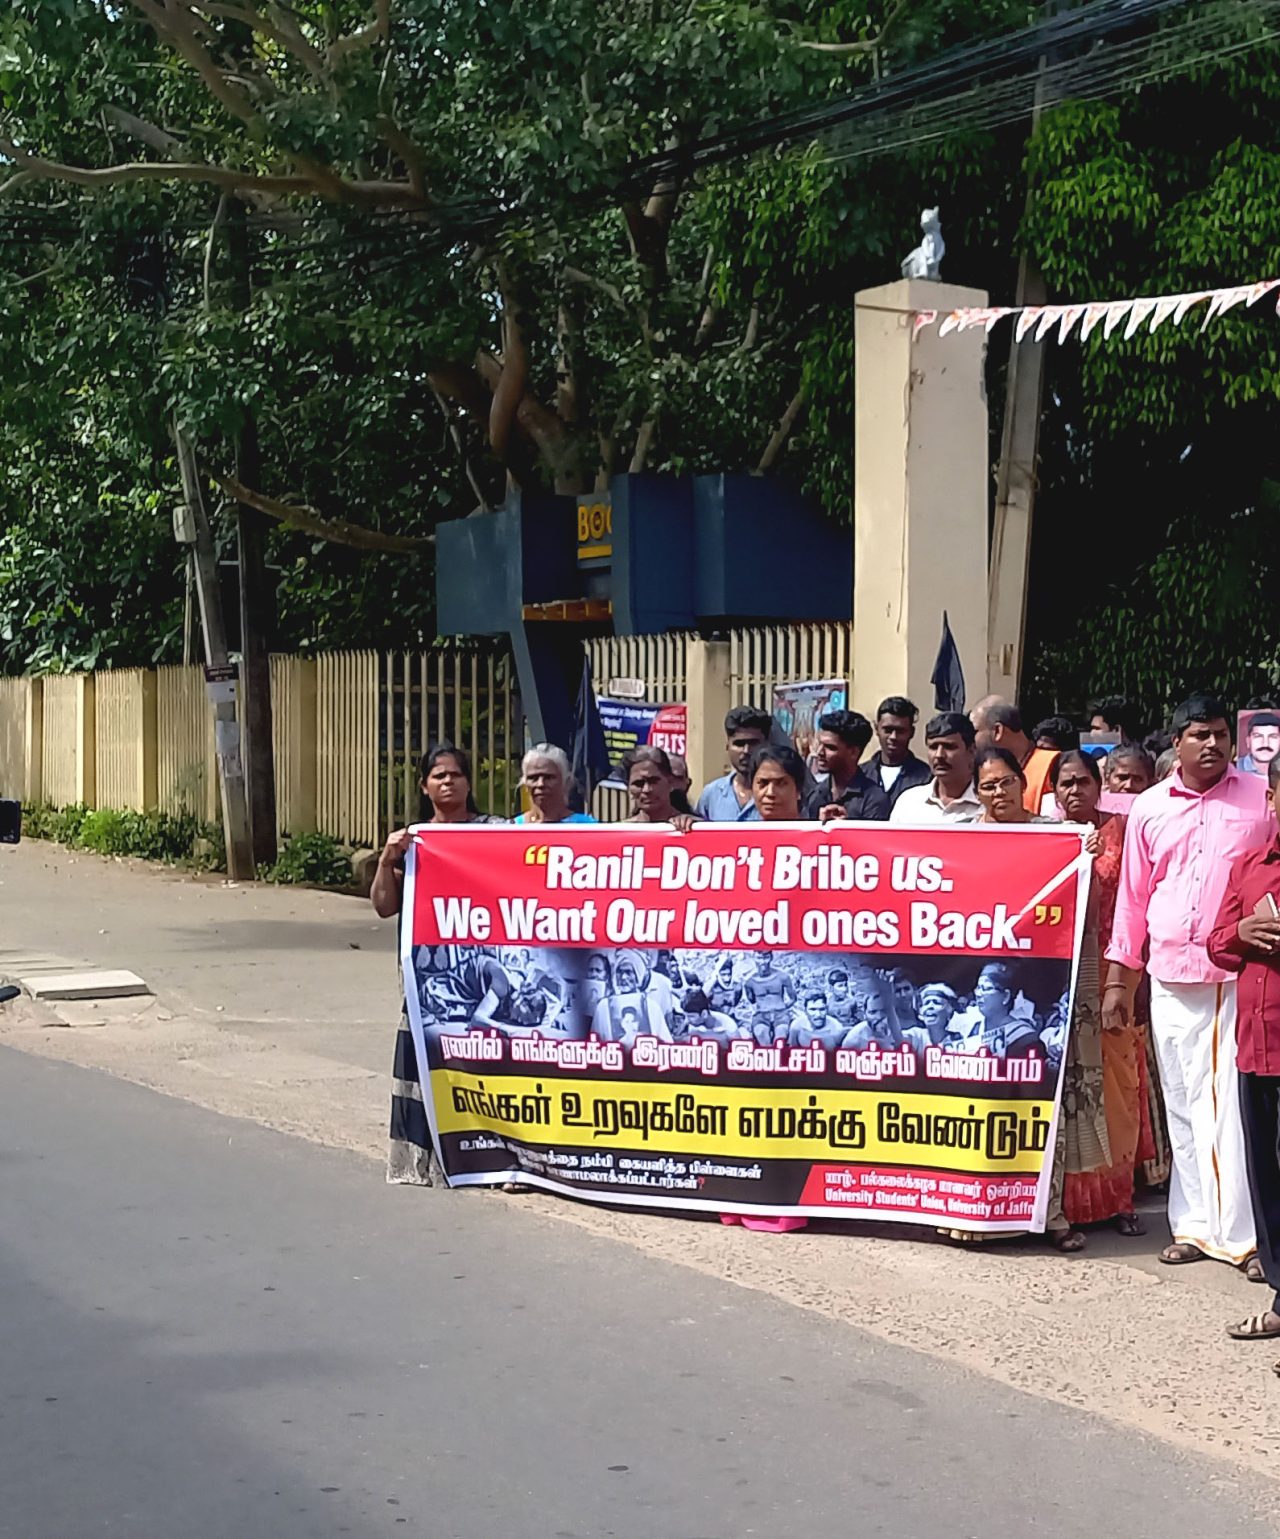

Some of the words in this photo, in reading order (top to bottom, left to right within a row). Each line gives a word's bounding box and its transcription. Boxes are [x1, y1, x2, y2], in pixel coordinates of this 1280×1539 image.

[652, 733, 685, 755] IELTS
[772, 845, 879, 891] Bribe
[891, 856, 954, 892] us.
[432, 897, 491, 940] We
[499, 898, 597, 942] Want
[606, 899, 676, 943] Our
[684, 900, 789, 945] loved
[802, 909, 899, 947] ones
[440, 1027, 503, 1060] ரணில்
[511, 1030, 624, 1070] எங்களுக்கு
[632, 1033, 718, 1075] இரண்டு
[727, 1038, 826, 1073] இலட்சம்
[836, 1042, 916, 1080] லஞ்சம்
[926, 1044, 1042, 1083] வேண்டாம்
[452, 1081, 552, 1126] எங்கள்
[561, 1092, 730, 1141] உறவுகளே
[738, 1095, 866, 1149] எமக்கு
[877, 1102, 1052, 1160] வேண்டும்
[825, 1188, 874, 1206] University
[920, 1194, 946, 1212] Union,
[947, 1198, 992, 1218] University
[993, 1202, 1006, 1215] of
